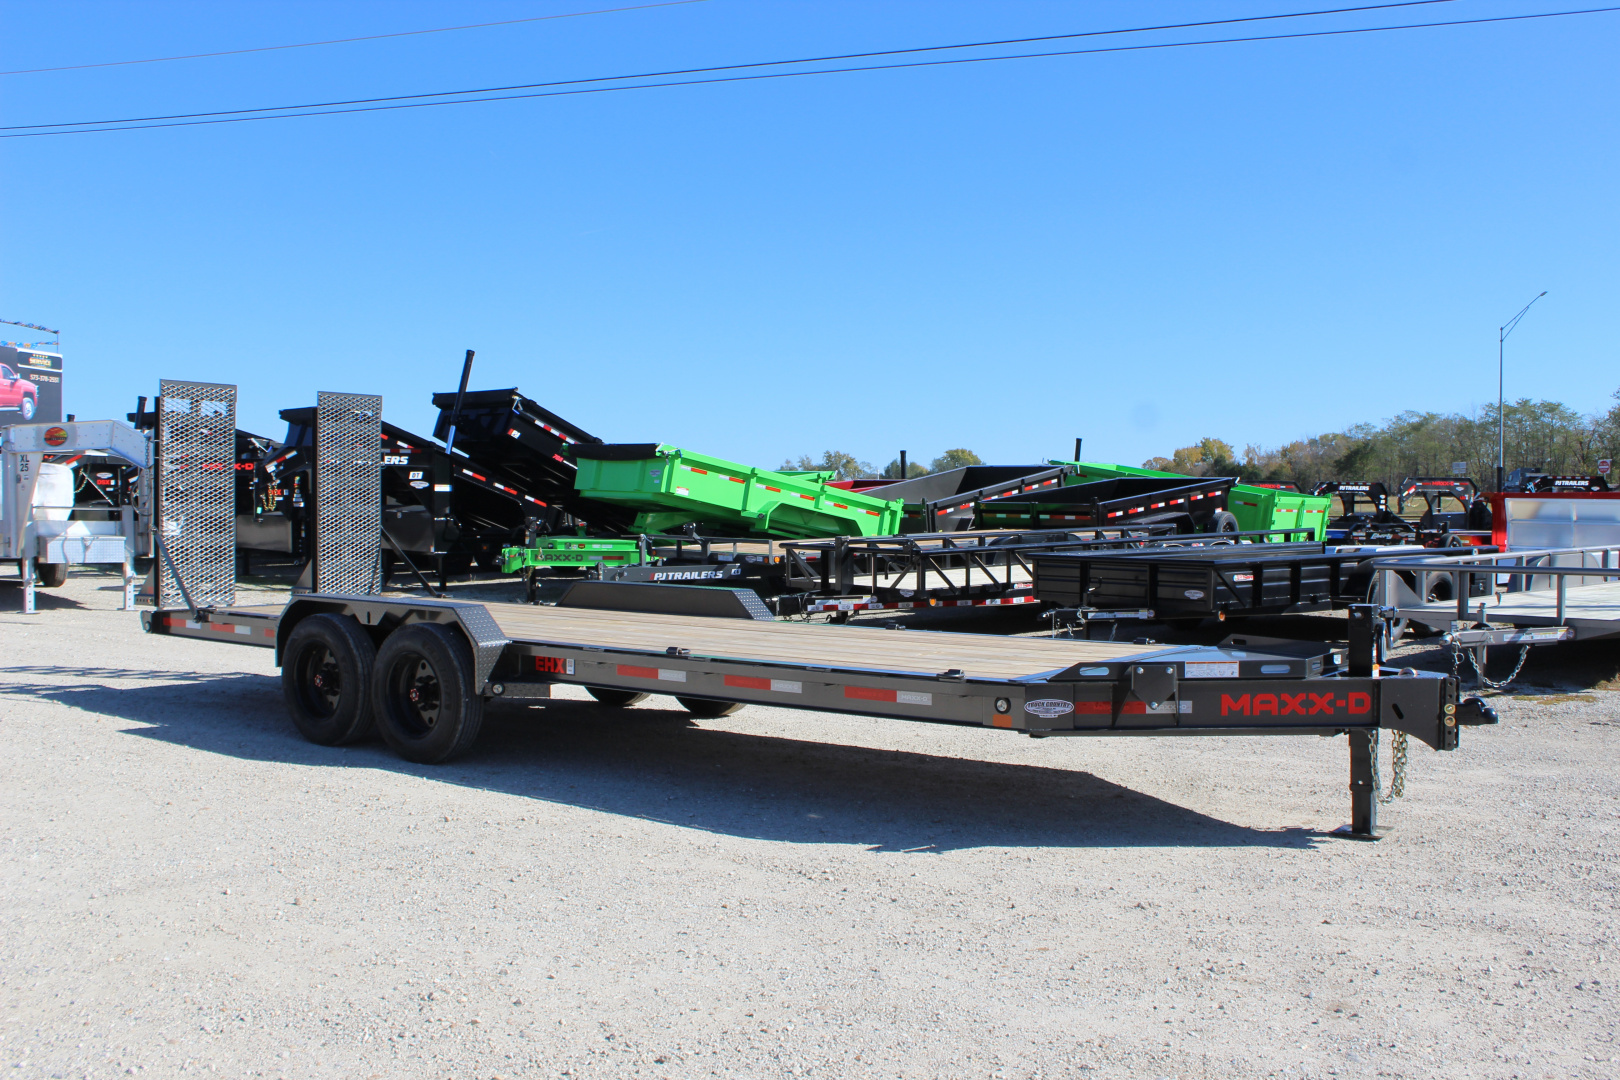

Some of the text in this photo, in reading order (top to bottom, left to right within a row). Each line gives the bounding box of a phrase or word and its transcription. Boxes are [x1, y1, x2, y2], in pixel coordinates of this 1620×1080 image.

[20, 454, 29, 462] XL
[20, 463, 29, 471] 25
[653, 572, 667, 580] PJ
[667, 570, 724, 580] TRAILERS
[535, 656, 565, 674] EHX
[901, 693, 928, 702] MAXX-D
[1221, 692, 1371, 716] MAXX-D
